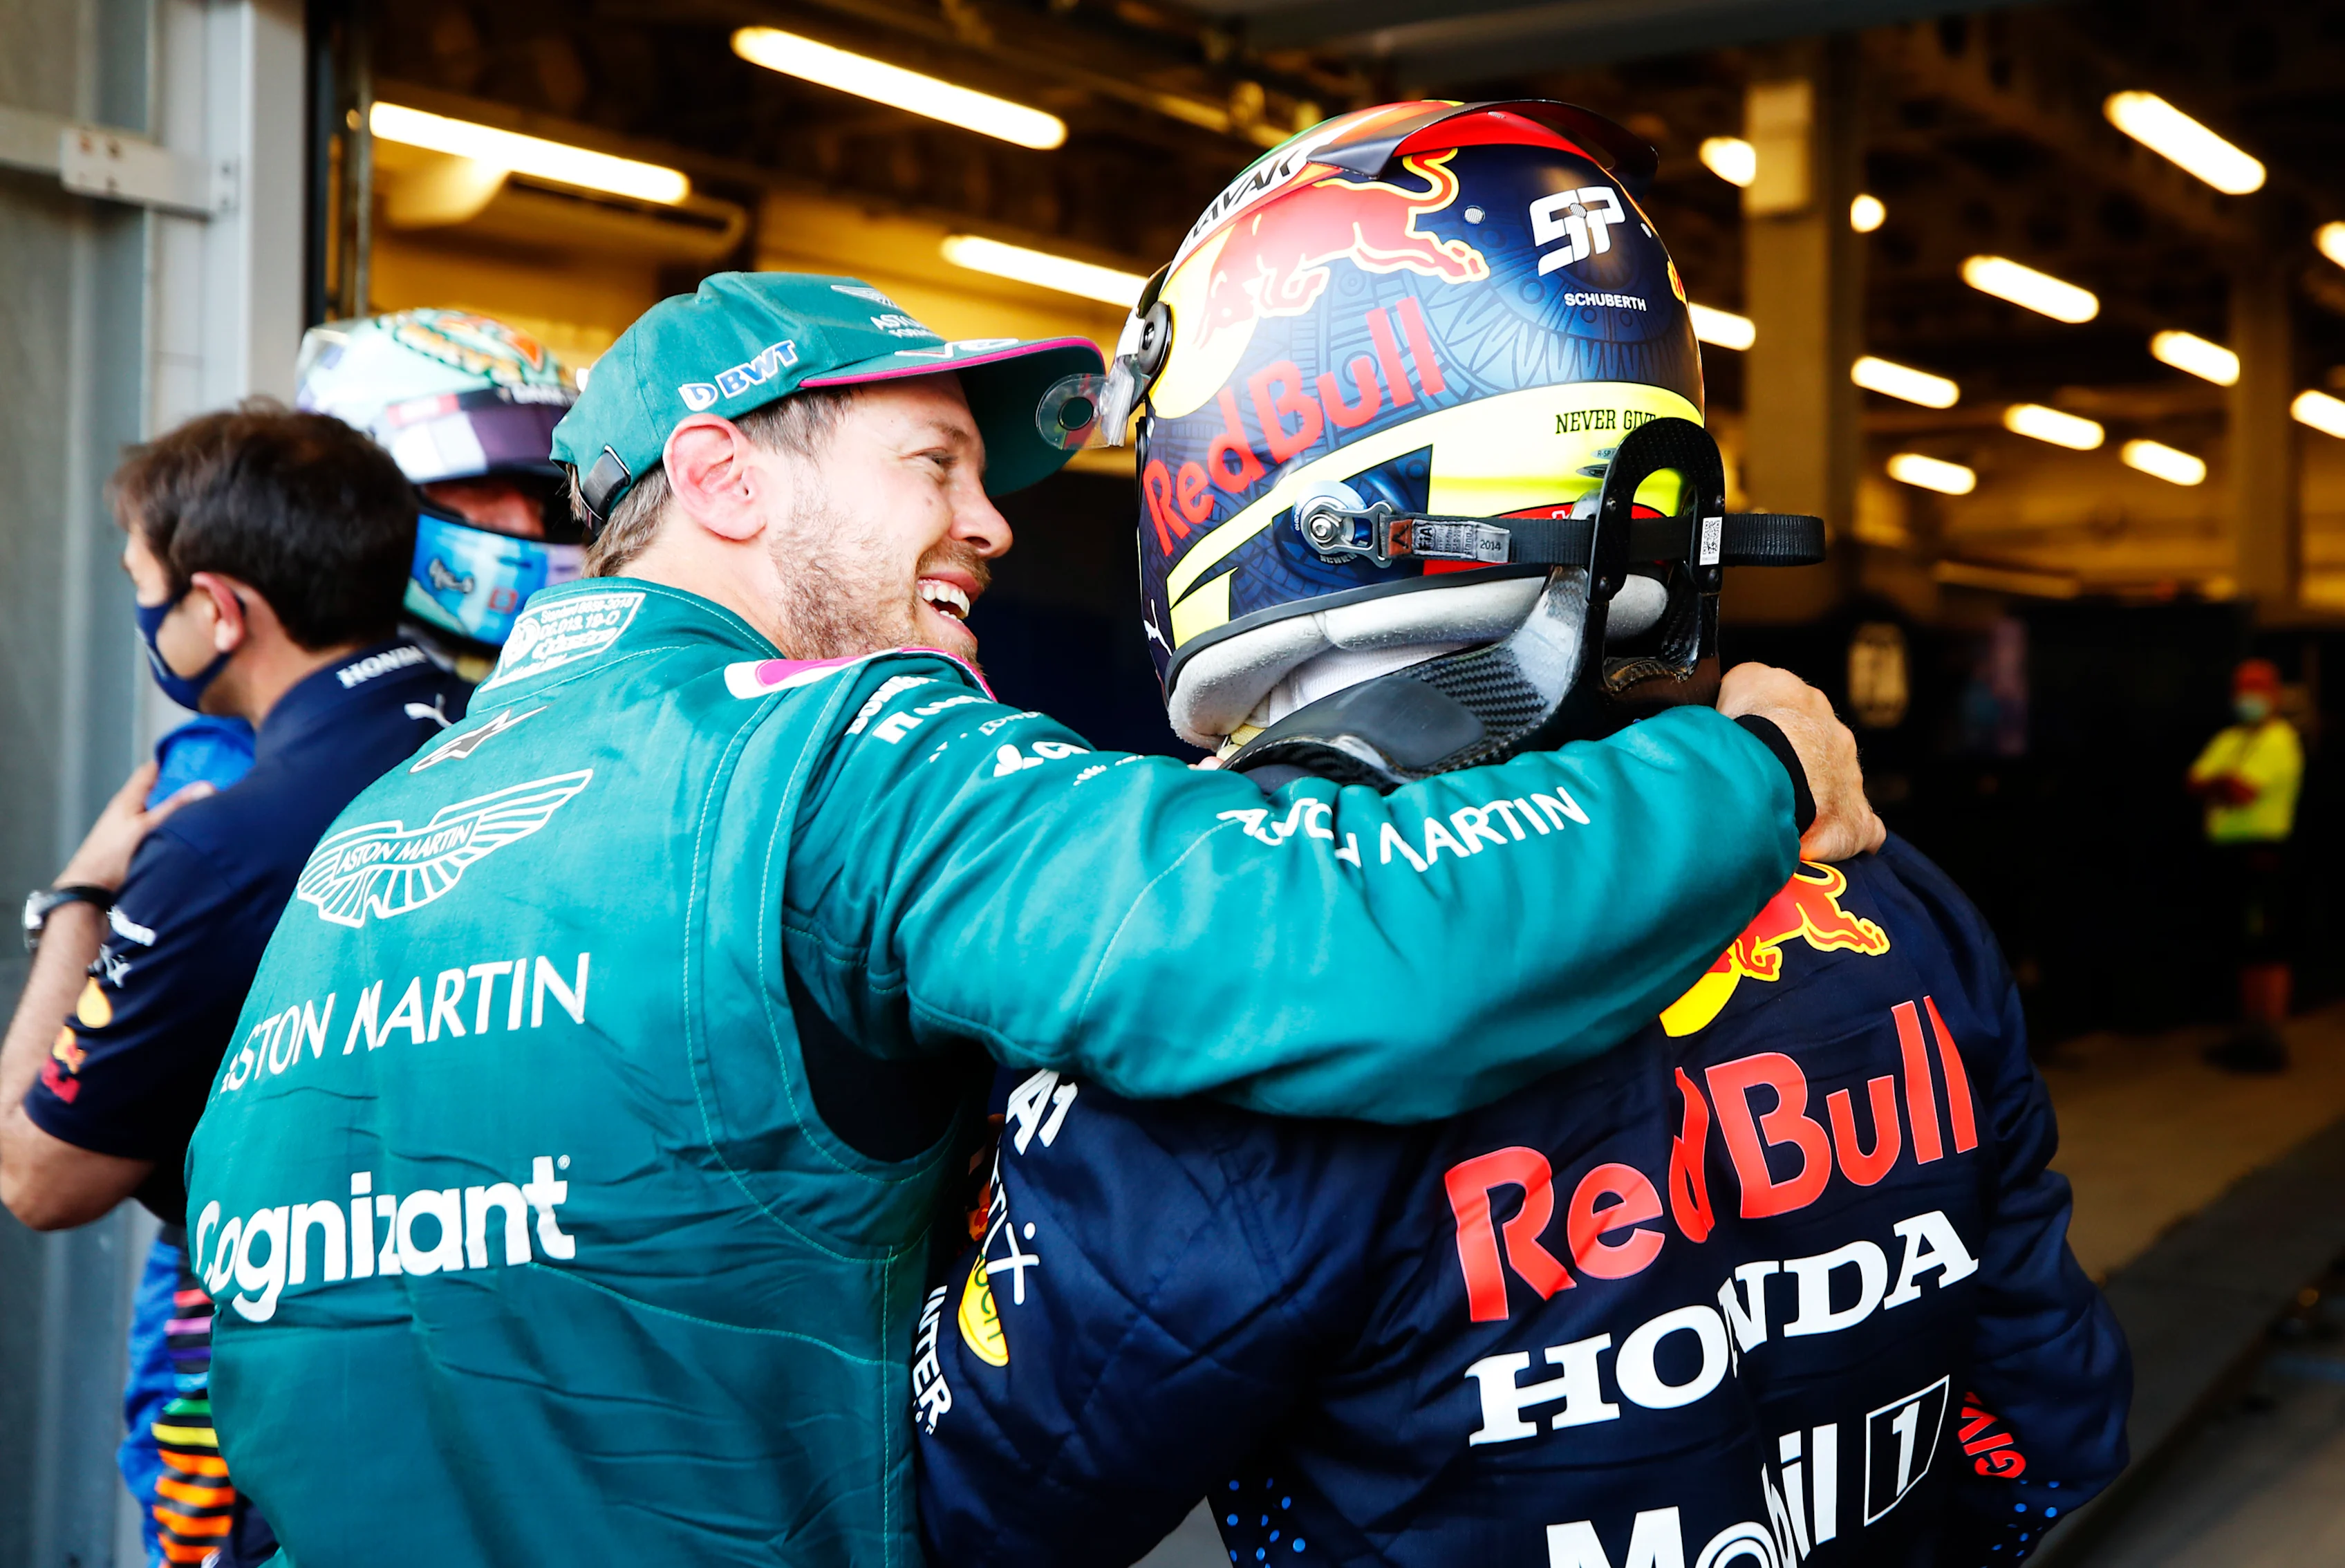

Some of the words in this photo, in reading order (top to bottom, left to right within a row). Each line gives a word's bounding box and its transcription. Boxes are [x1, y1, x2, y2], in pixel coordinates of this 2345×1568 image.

[1563, 292, 1647, 312] SCHUBERTH
[715, 339, 798, 400] BWT
[1143, 386, 1267, 557] Red
[1247, 296, 1446, 464] Bull
[1555, 409, 1616, 435] NEVER
[1479, 539, 1502, 551] 2014
[335, 645, 427, 689] HONDA
[339, 841, 393, 873] ASTON
[393, 821, 474, 862] MARTIN
[1379, 786, 1591, 872] MARTIN
[342, 951, 590, 1056] MARTIN
[1444, 1065, 1716, 1322] Red
[1705, 995, 1978, 1219] Bull
[196, 1155, 577, 1323] Cognizant
[913, 1285, 953, 1429] INTER
[1464, 1210, 1979, 1446] HONDA
